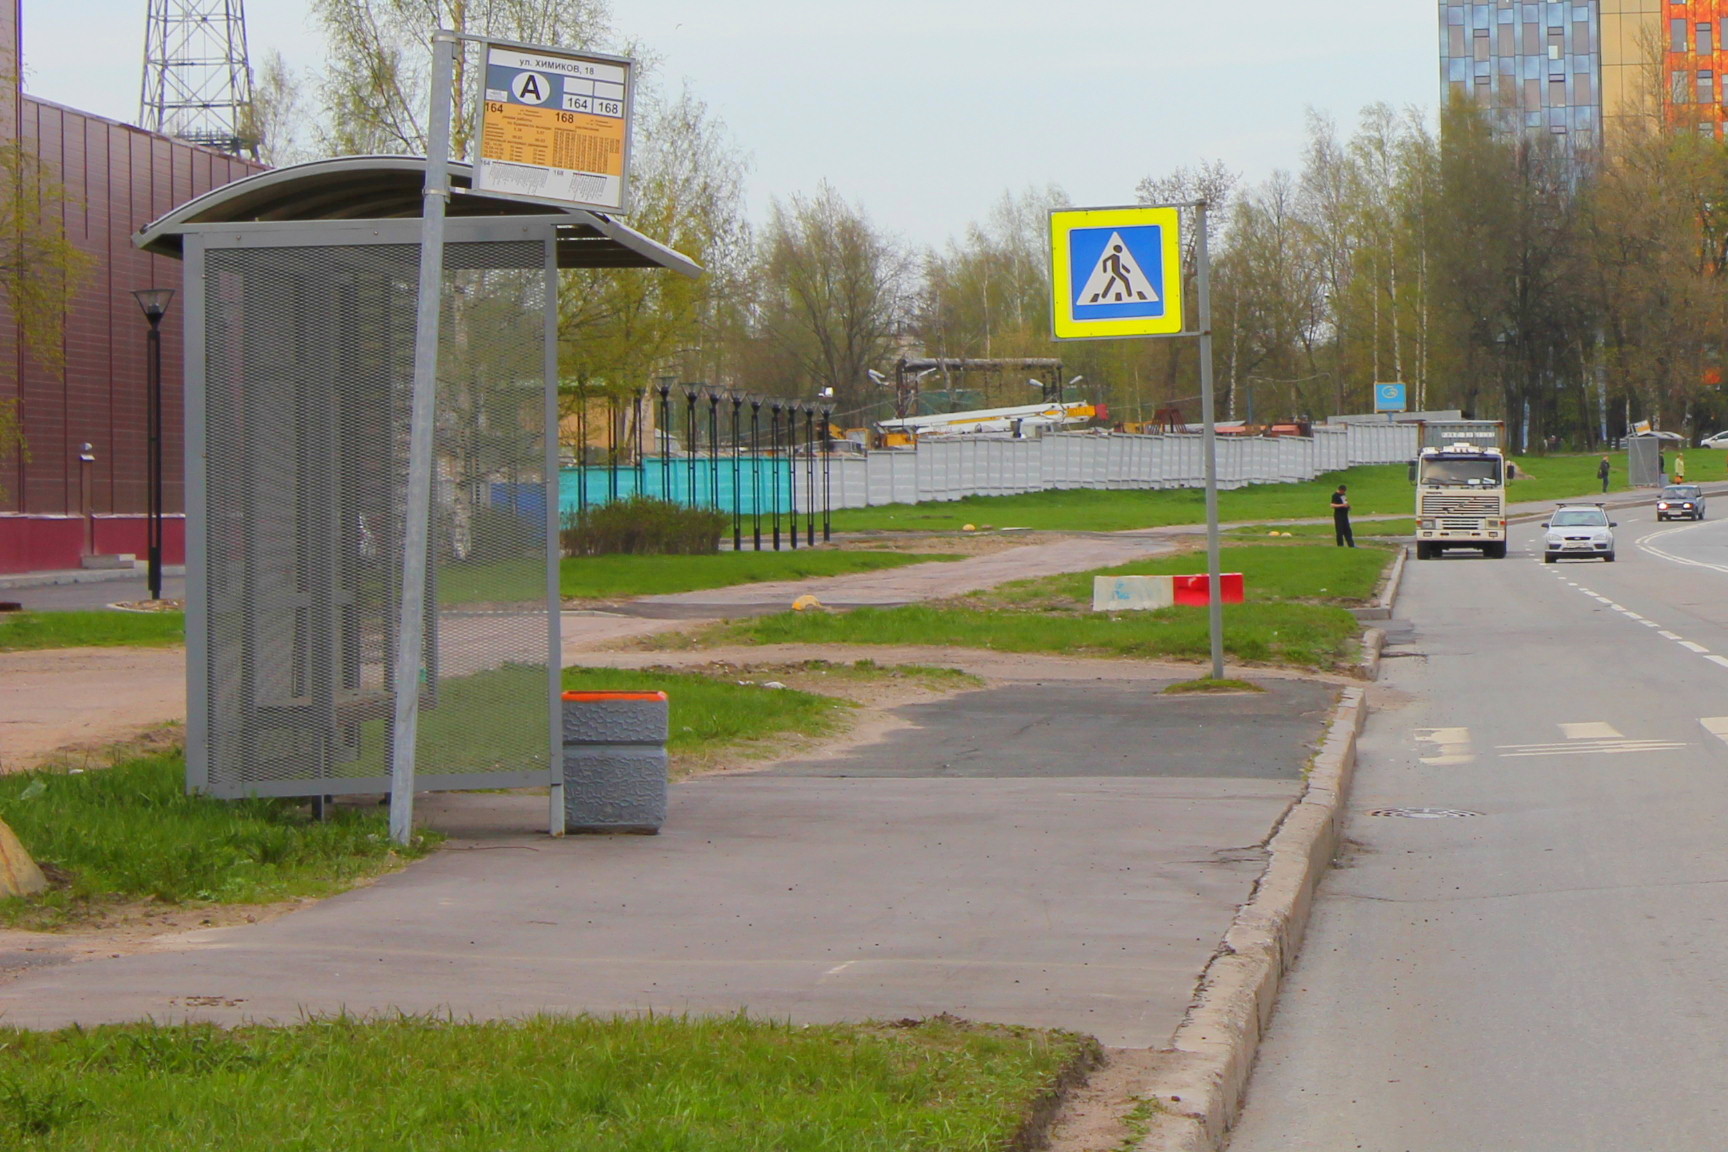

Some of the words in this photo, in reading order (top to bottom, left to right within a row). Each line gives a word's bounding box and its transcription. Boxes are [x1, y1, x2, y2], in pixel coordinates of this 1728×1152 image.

[519, 59, 532, 67] ул.
[535, 59, 582, 75] ХИМИКОВ,
[585, 67, 595, 75] 18
[519, 74, 541, 101] А
[485, 102, 503, 114] 164
[567, 97, 588, 110] 164
[598, 102, 618, 114] 168
[555, 112, 574, 124] 168
